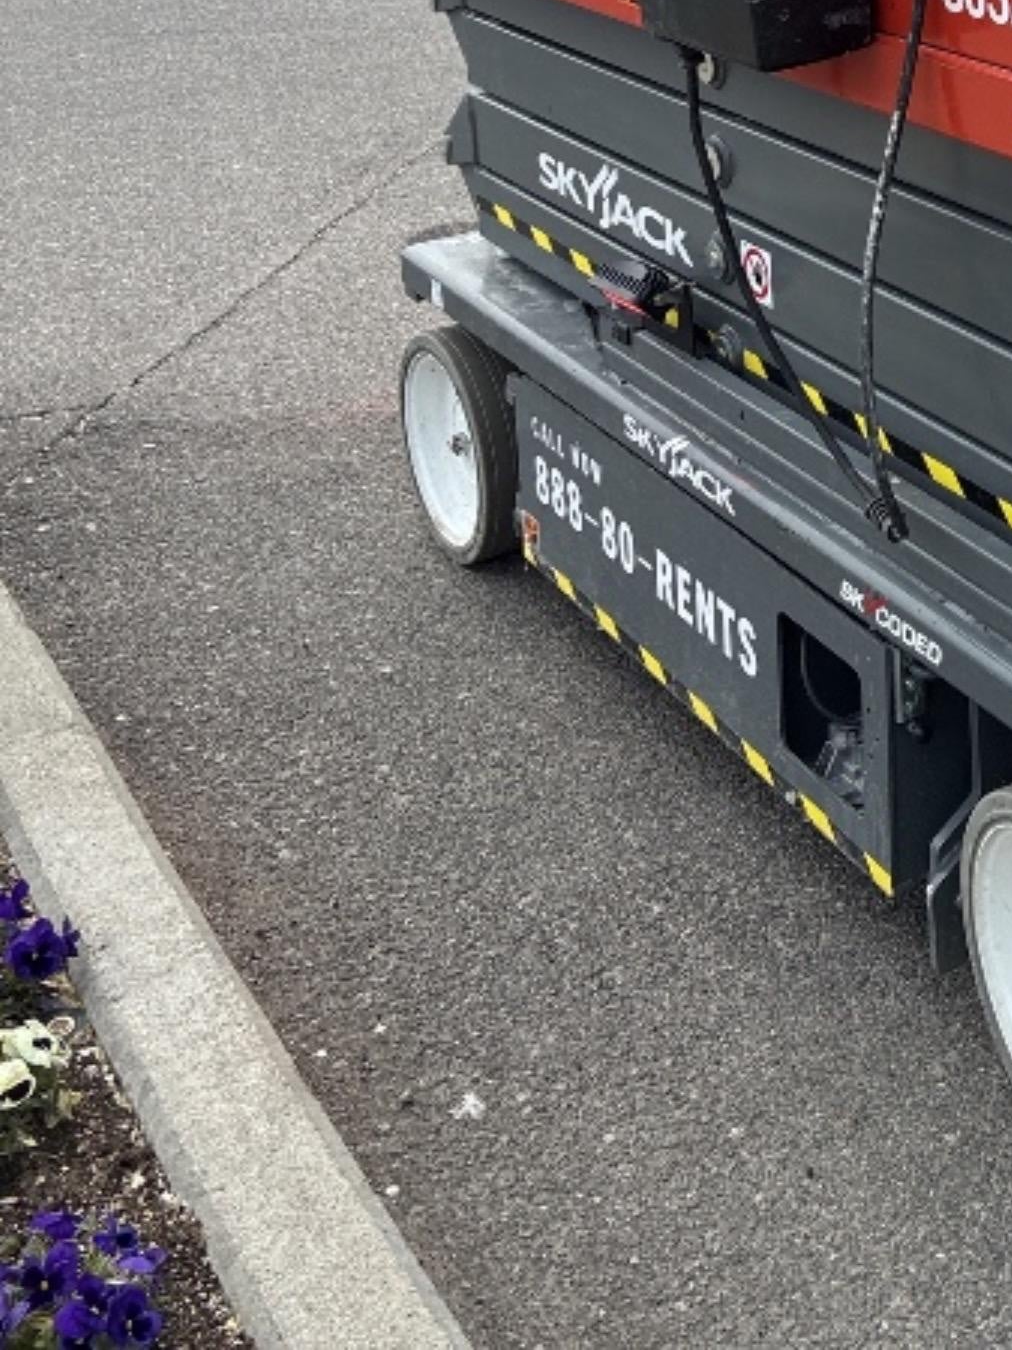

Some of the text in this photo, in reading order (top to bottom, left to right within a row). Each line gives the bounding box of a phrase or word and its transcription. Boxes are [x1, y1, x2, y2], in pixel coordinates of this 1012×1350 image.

[538, 152, 694, 268] SKYJACK
[530, 416, 565, 458] CALL
[623, 413, 736, 516] SKYJACK
[534, 455, 758, 678] 888-80-RENTS
